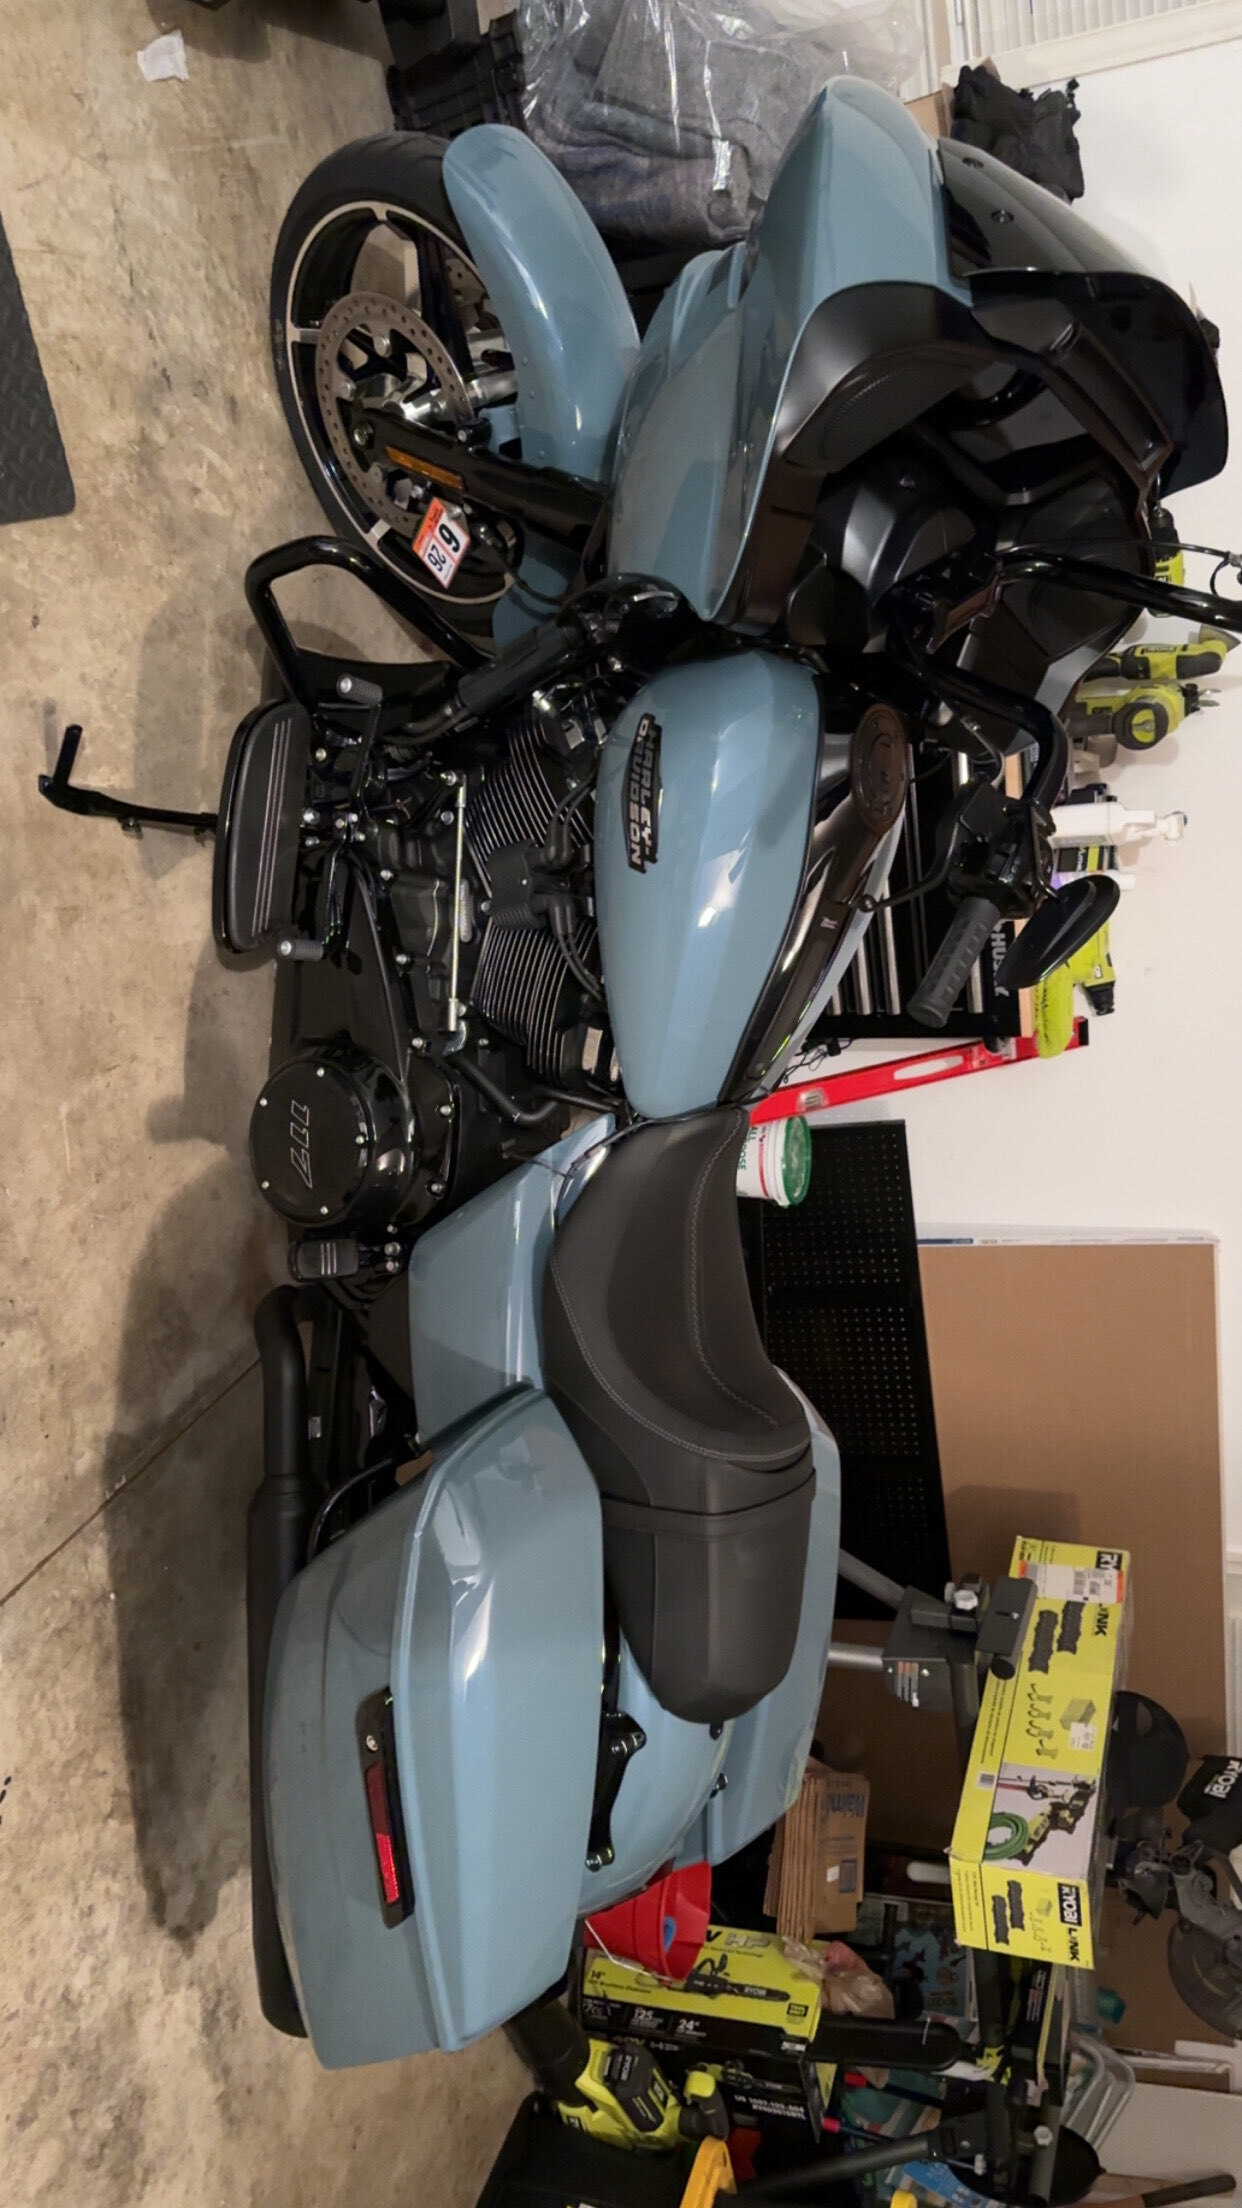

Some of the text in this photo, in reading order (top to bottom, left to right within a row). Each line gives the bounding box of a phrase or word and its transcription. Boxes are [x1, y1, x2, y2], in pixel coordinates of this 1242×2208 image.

[437, 524, 461, 553] 6
[427, 544, 447, 572] 26
[629, 718, 650, 866] DAVIDSON
[640, 729, 658, 856] HARLEY-
[991, 933, 1010, 997] HUSY
[289, 1100, 313, 1189] 117
[1208, 1760, 1242, 1798] RYOBI
[1061, 1886, 1079, 1924] RYOBI
[620, 2055, 632, 2081] RYOBI
